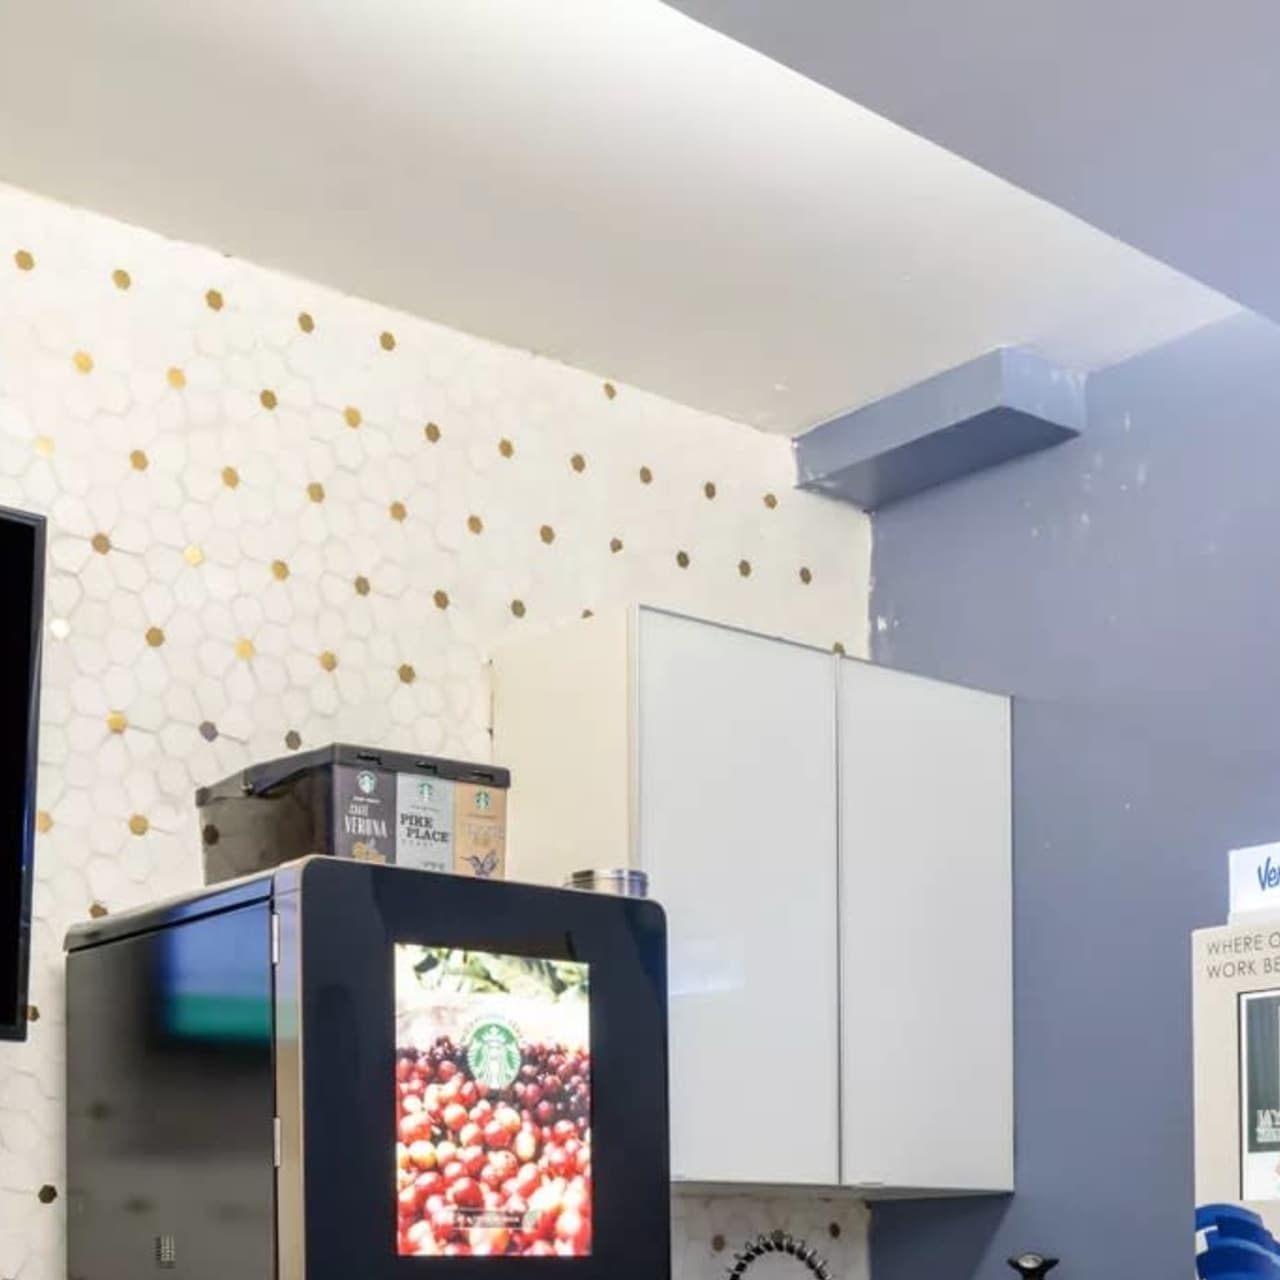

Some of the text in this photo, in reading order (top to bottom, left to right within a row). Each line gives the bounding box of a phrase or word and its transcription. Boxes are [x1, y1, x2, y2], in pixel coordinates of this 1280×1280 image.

[400, 812, 433, 829] PIKE
[406, 827, 450, 843] PLACE
[1206, 934, 1264, 956] WHERE
[1206, 961, 1258, 979] WORK
